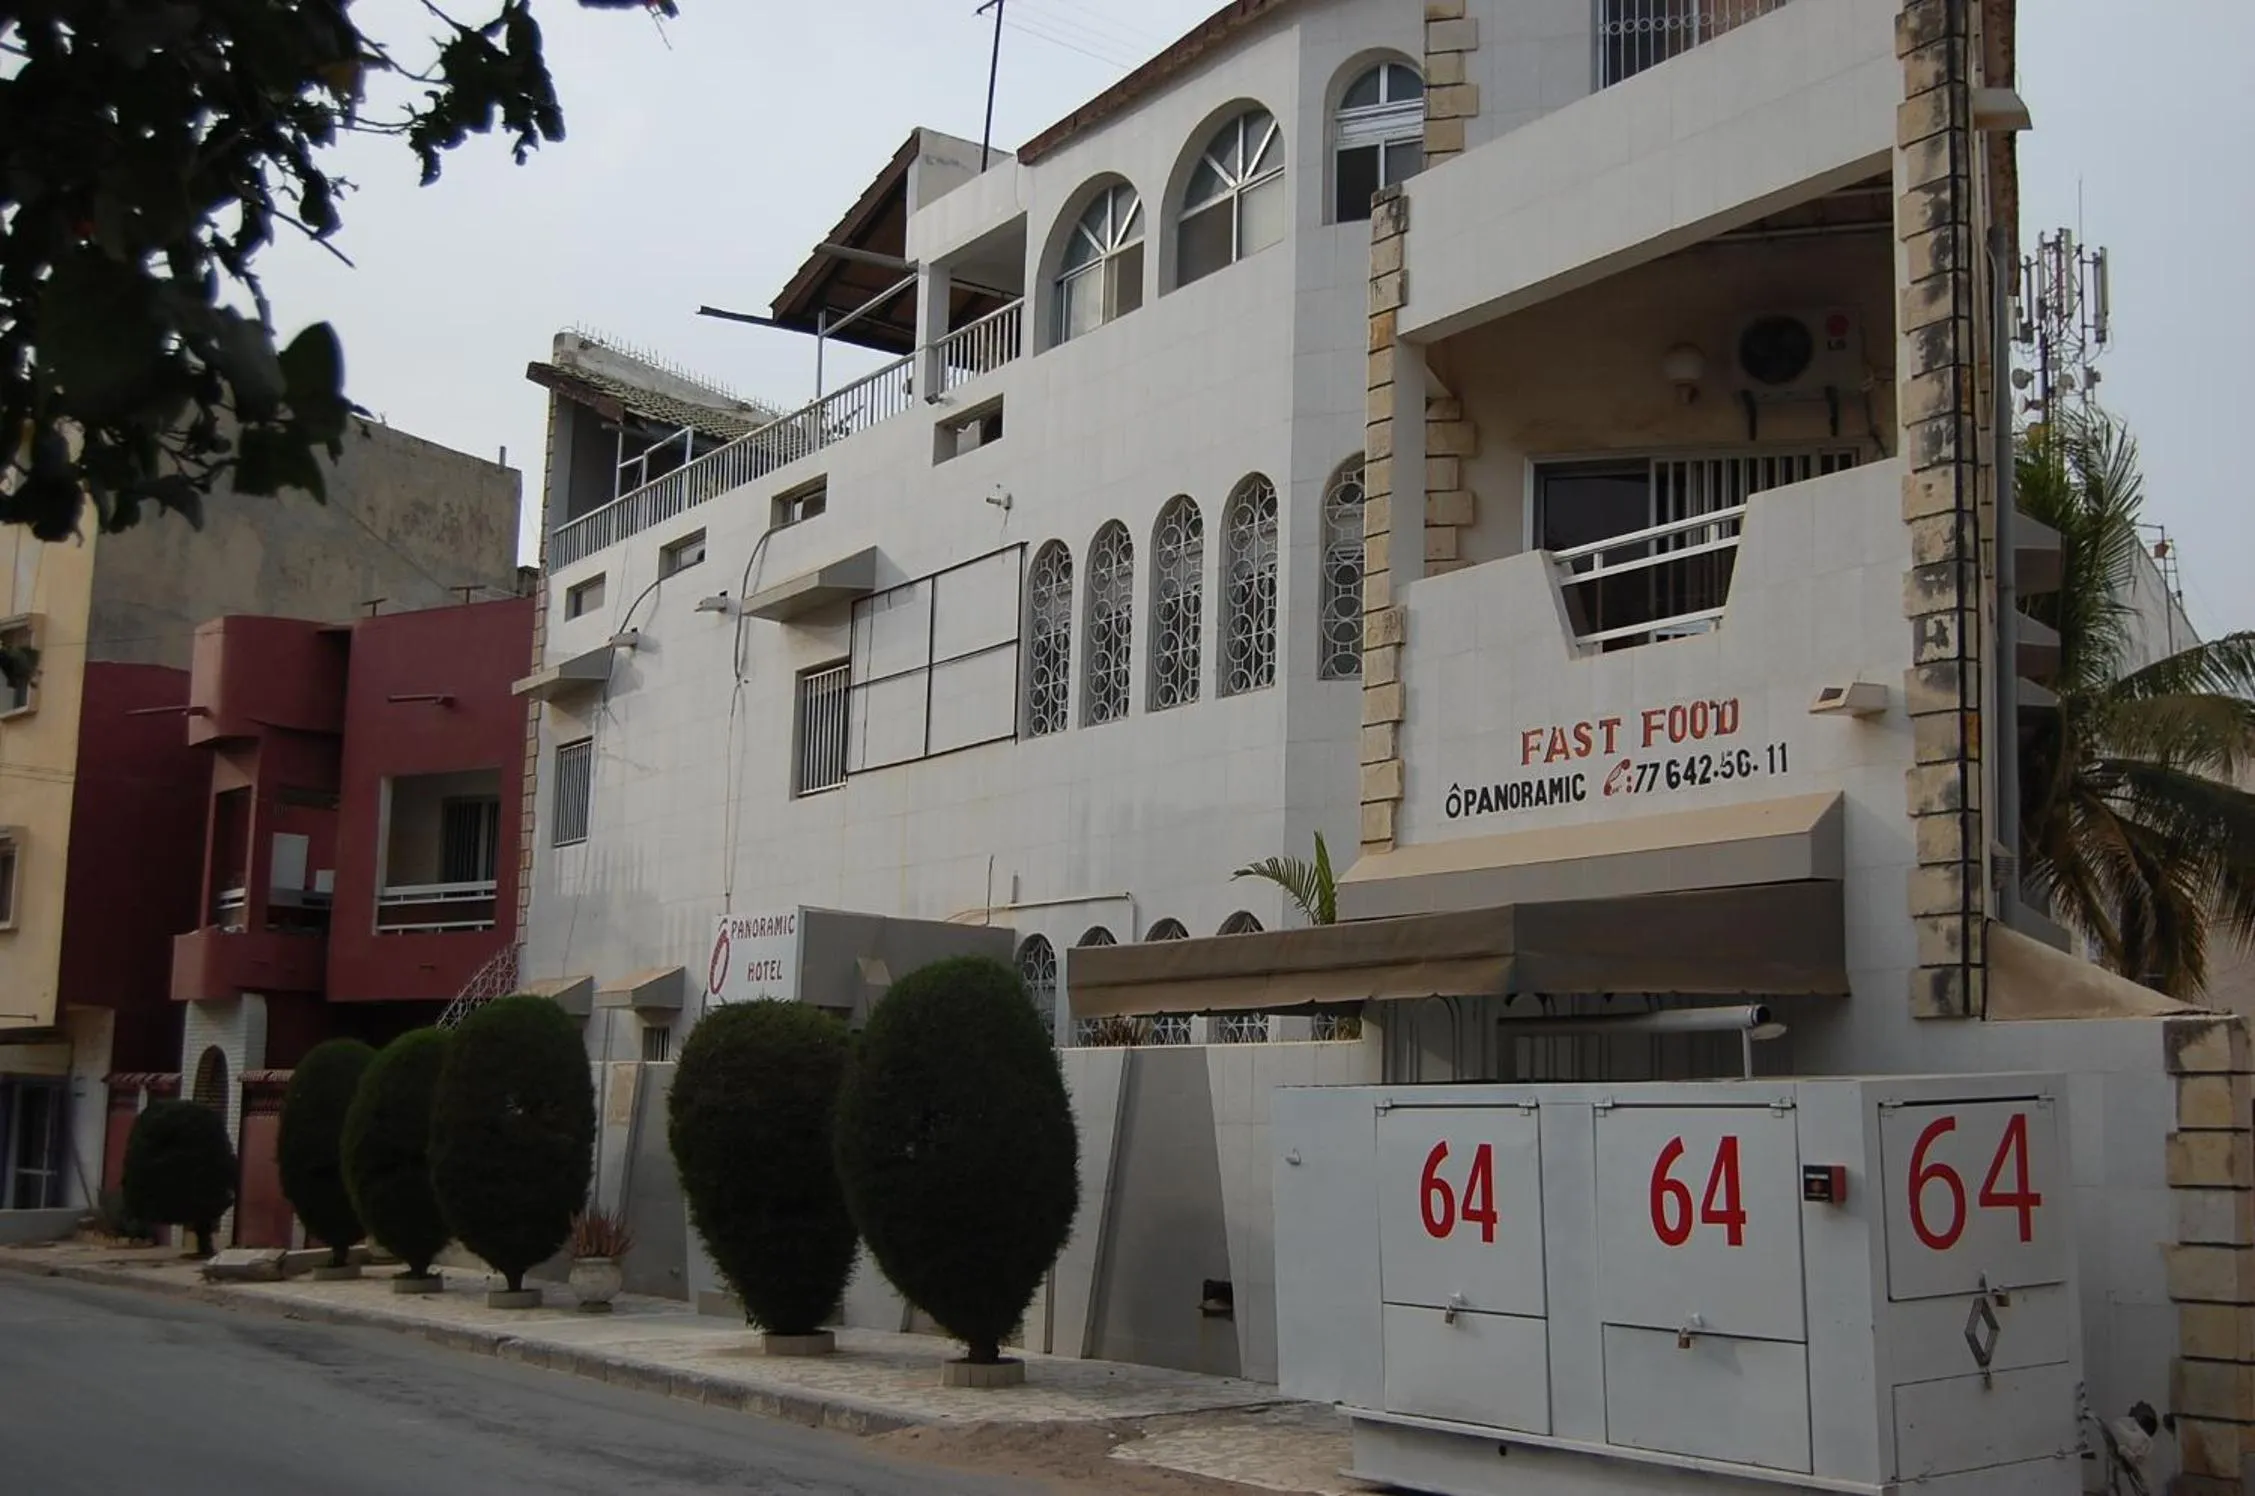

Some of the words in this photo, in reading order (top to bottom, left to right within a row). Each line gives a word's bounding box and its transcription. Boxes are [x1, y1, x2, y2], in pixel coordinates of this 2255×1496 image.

[1520, 718, 1621, 766] FAST
[1641, 697, 1739, 748] FOOD
[731, 914, 796, 939] PANORAMIC
[747, 959, 783, 982] HOTEL
[1420, 1139, 1498, 1244] 64
[1650, 1135, 1747, 1246] 64
[1909, 1113, 2041, 1250] 64
